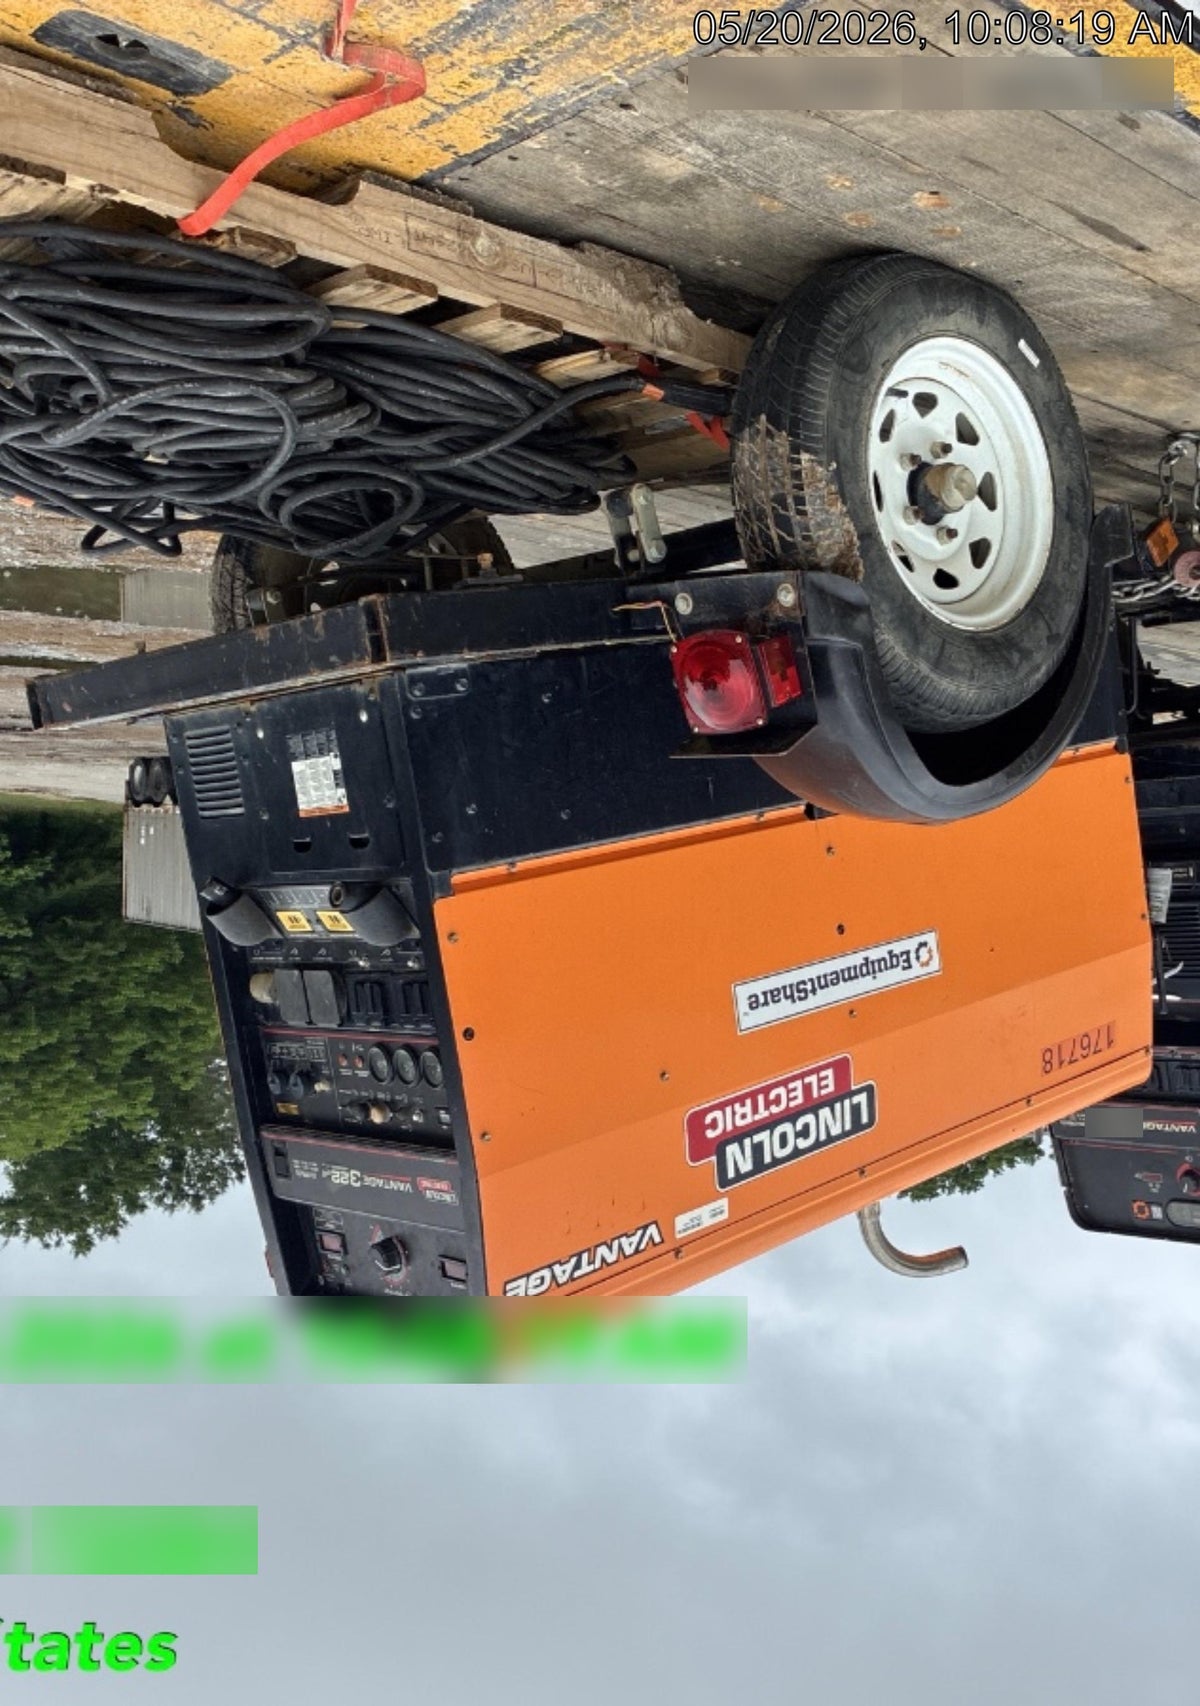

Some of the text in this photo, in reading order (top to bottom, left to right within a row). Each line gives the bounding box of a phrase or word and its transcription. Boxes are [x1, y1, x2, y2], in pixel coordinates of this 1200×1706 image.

[747, 949, 913, 1011] EquipmentShare
[1042, 1024, 1115, 1074] 176718
[704, 1067, 836, 1139] ELECTRIC
[725, 1091, 870, 1180] LINCOLN
[331, 1169, 361, 1188] 322
[363, 1176, 414, 1193] VANTAGE
[504, 1221, 663, 1296] VANTAGE
